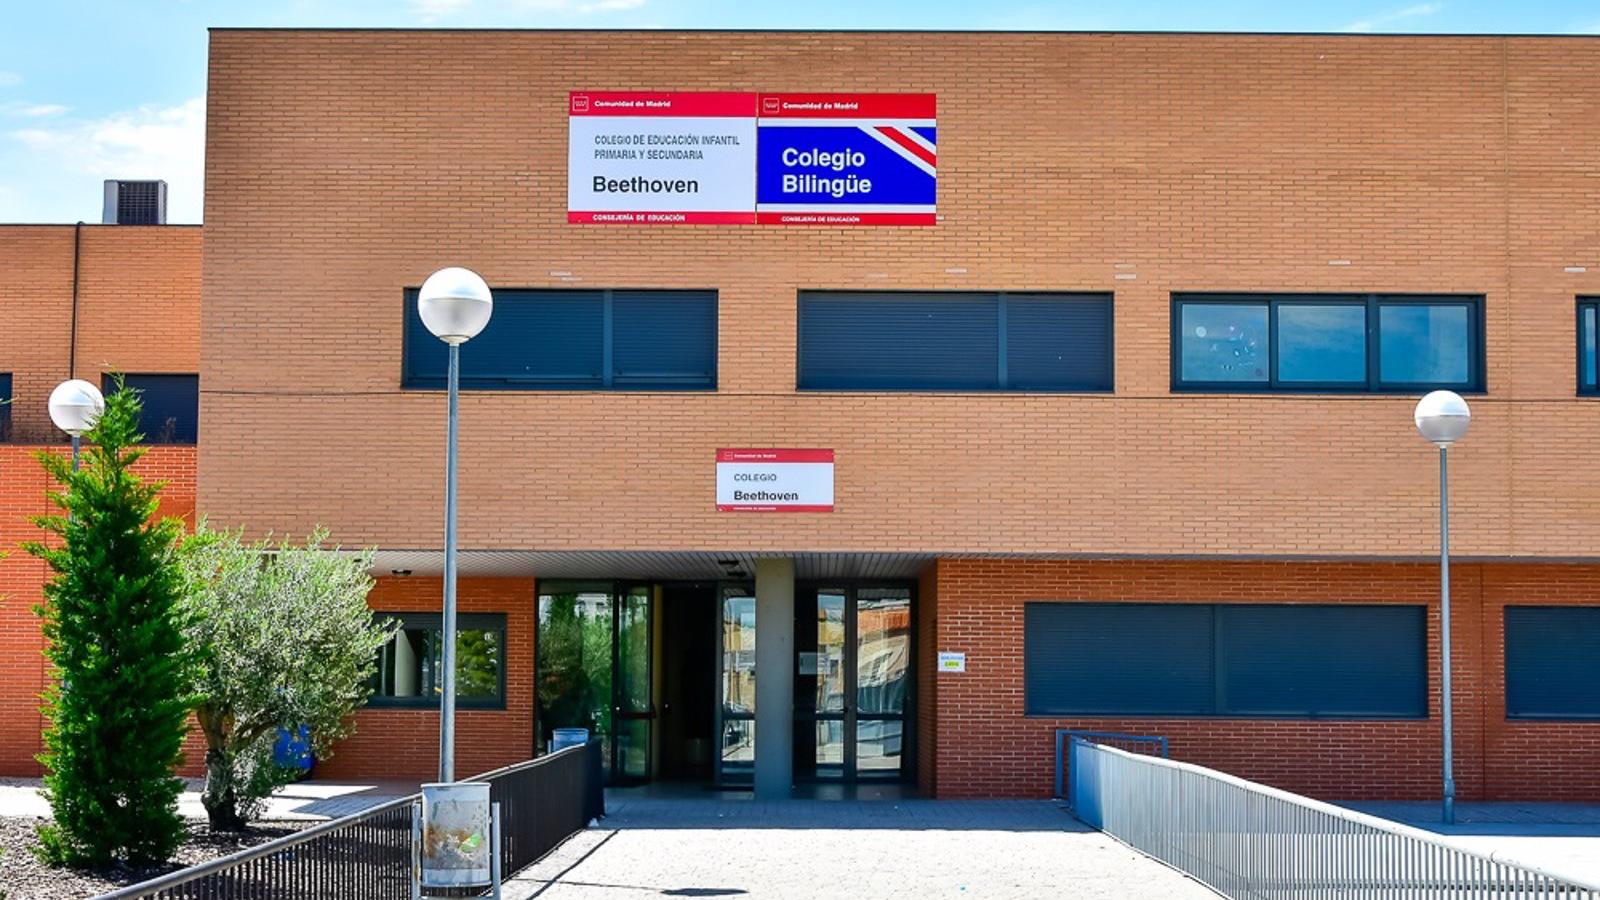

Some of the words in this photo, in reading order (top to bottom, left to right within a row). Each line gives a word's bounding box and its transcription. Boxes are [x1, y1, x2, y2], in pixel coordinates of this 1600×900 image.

[594, 134, 631, 145] COLEGIO
[633, 134, 645, 145] DE
[647, 133, 699, 145] EDUCACIÓN
[701, 135, 740, 145] INFANTIL
[594, 149, 637, 159] PRIMARIA
[638, 149, 646, 159] Y
[647, 149, 704, 160] SECUNDARIA
[782, 147, 866, 171] Colegio
[592, 175, 699, 193] Beethoven
[782, 174, 872, 198] Bilingüe
[734, 474, 777, 482] COLEGIO
[733, 490, 799, 501] Beethoven
